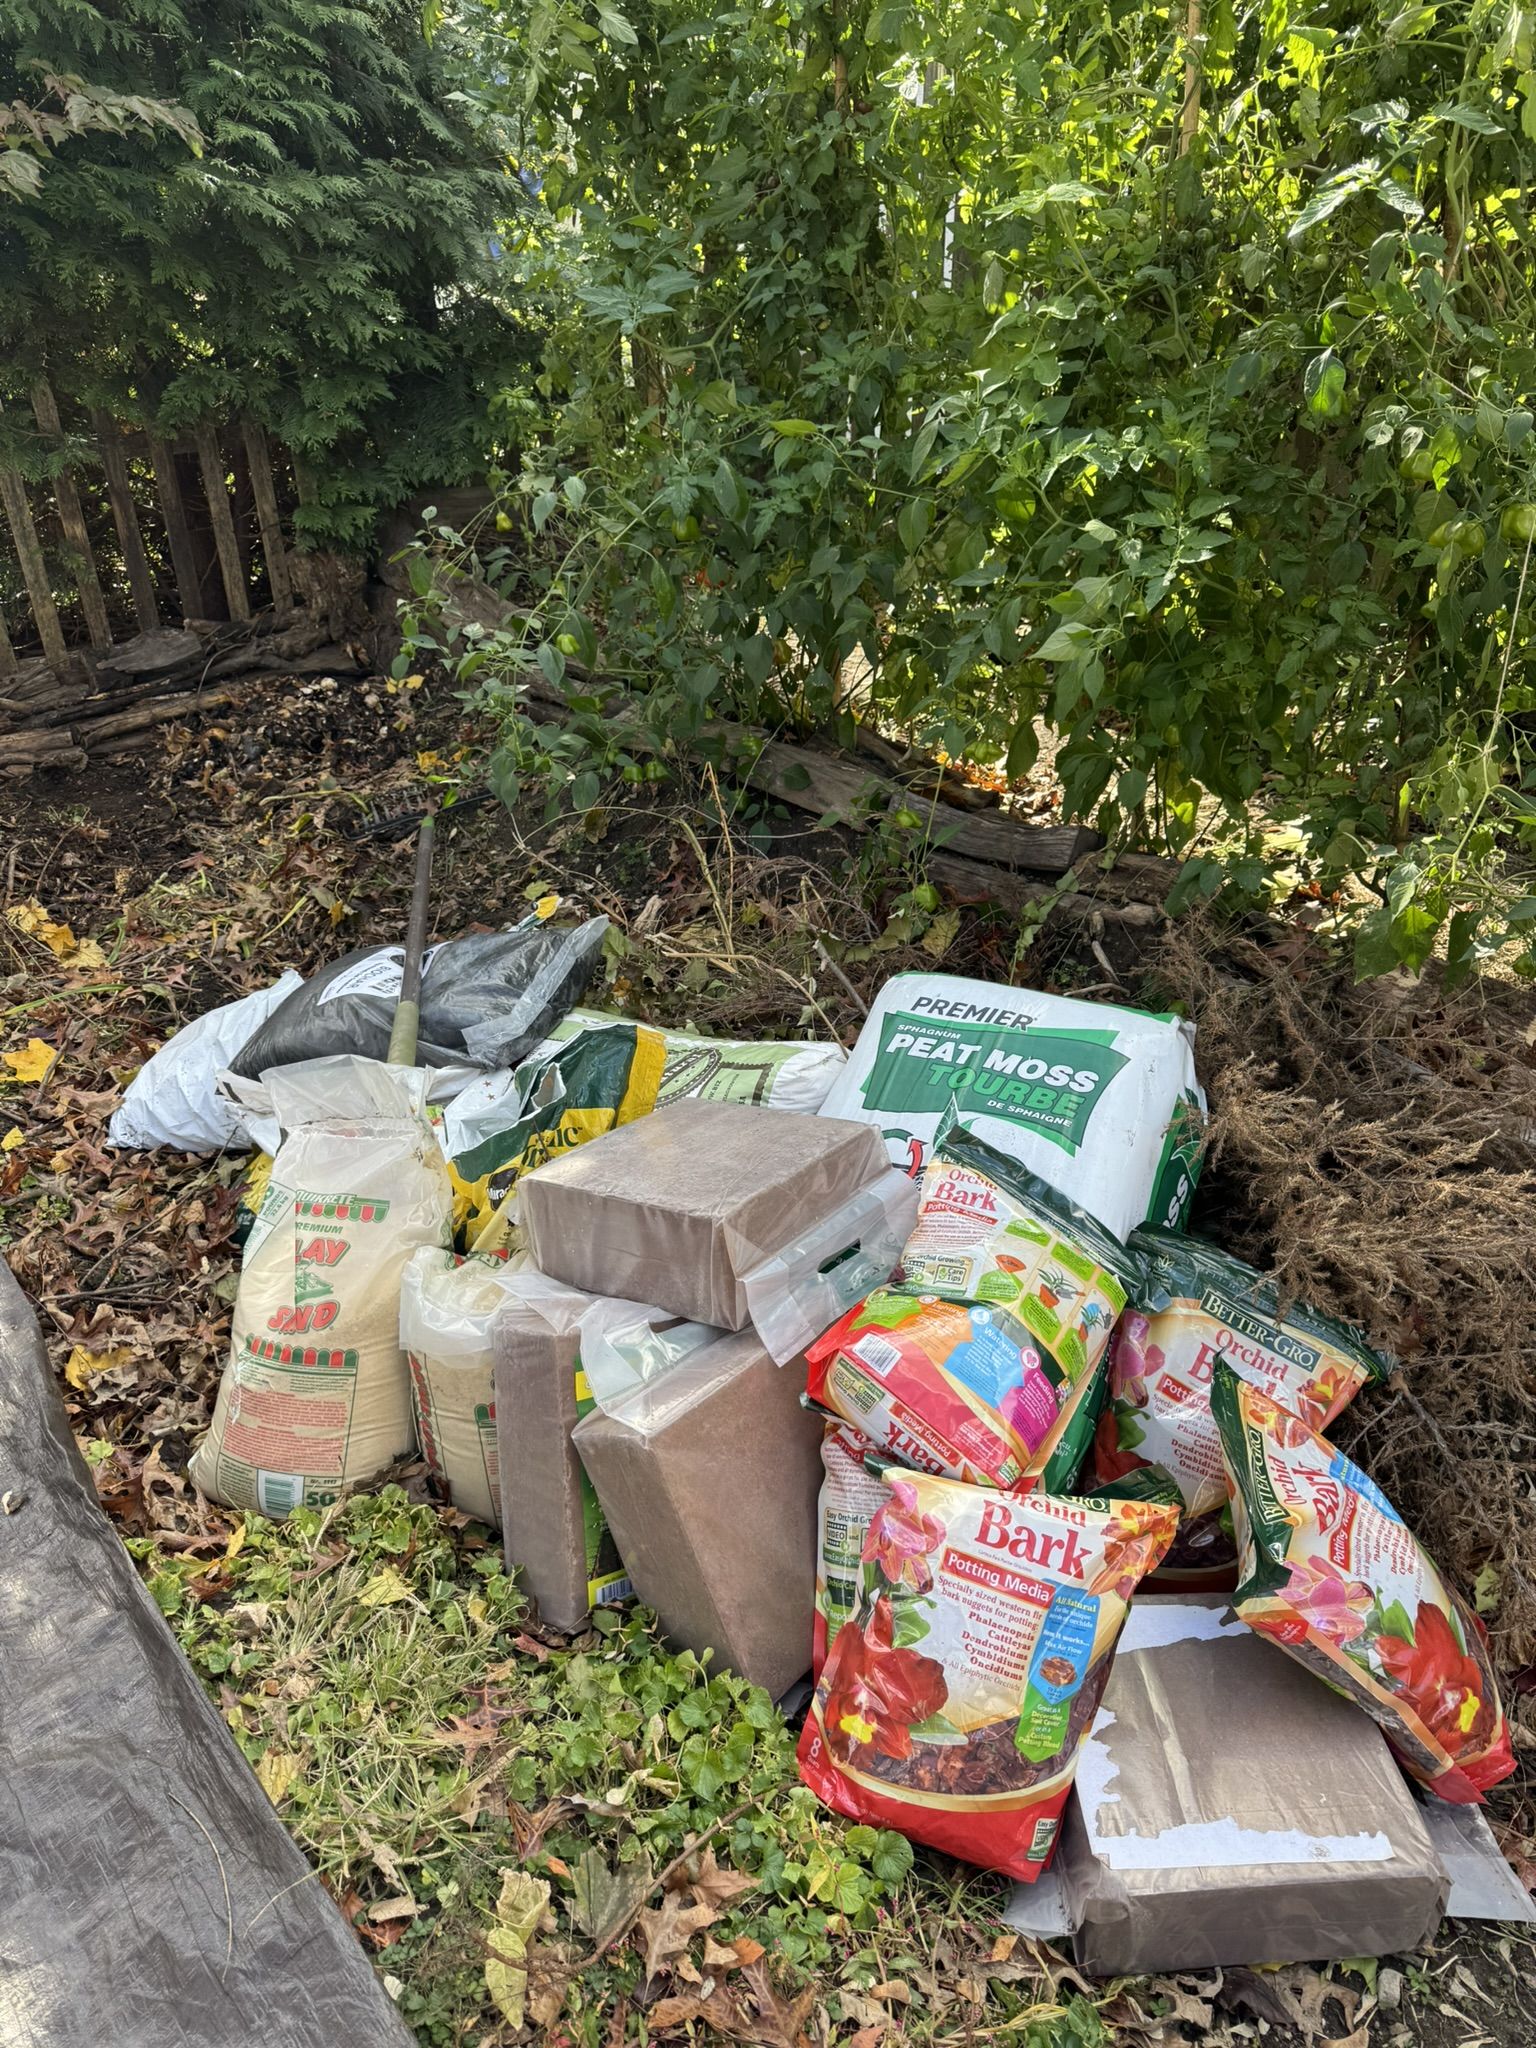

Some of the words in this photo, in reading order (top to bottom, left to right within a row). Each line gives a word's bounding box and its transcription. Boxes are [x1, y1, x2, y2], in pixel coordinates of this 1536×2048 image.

[910, 995, 1034, 1032] PREMIER
[897, 1024, 962, 1041] SPHAGNUM
[885, 1033, 982, 1065] PEAT
[982, 1050, 1100, 1094] MOSS
[928, 1063, 1087, 1120] TOURBE
[986, 1099, 1006, 1111] DE
[1006, 1104, 1073, 1129] SPHAIGNE
[933, 1181, 997, 1212] Bark
[295, 1222, 344, 1234] REMIUM
[295, 1237, 351, 1268] LAY
[1204, 1294, 1314, 1367] BETTER-GRO
[1215, 1328, 1289, 1382] Orchid
[901, 1412, 925, 1434] Media
[882, 1420, 947, 1476] Bark
[924, 1430, 951, 1458] Potting
[1267, 1454, 1308, 1505] Orchid
[998, 1489, 1087, 1528] Orchid
[1290, 1460, 1340, 1537] Bark
[826, 1510, 837, 1521] Easy
[837, 1512, 859, 1524] Orchid
[974, 1499, 1093, 1580] Bark
[1333, 1527, 1348, 1566] Potting
[948, 1553, 1000, 1586] Potting
[1004, 1575, 1050, 1603] Media
[938, 1575, 973, 1596] Specially
[975, 1590, 998, 1604] sized
[999, 1599, 1031, 1617] western
[1033, 1610, 1043, 1621] fir
[941, 1587, 960, 1601] bark
[961, 1596, 993, 1613] nuggets
[994, 1607, 1008, 1619] for
[968, 1610, 1035, 1642] Phalaenopsis
[1069, 1617, 1093, 1629] orchids
[961, 1630, 1028, 1661] Dendrobiums
[987, 1629, 1032, 1651] Cattleyas
[964, 1643, 1025, 1671] Cymbidiums
[970, 1656, 1023, 1681] Oncidiums
[948, 1659, 959, 1670] All
[959, 1662, 994, 1682] Epiphytic
[993, 1676, 1021, 1692] Orchids
[810, 1737, 822, 1758] 8
[1018, 1736, 1043, 1748] Potting
